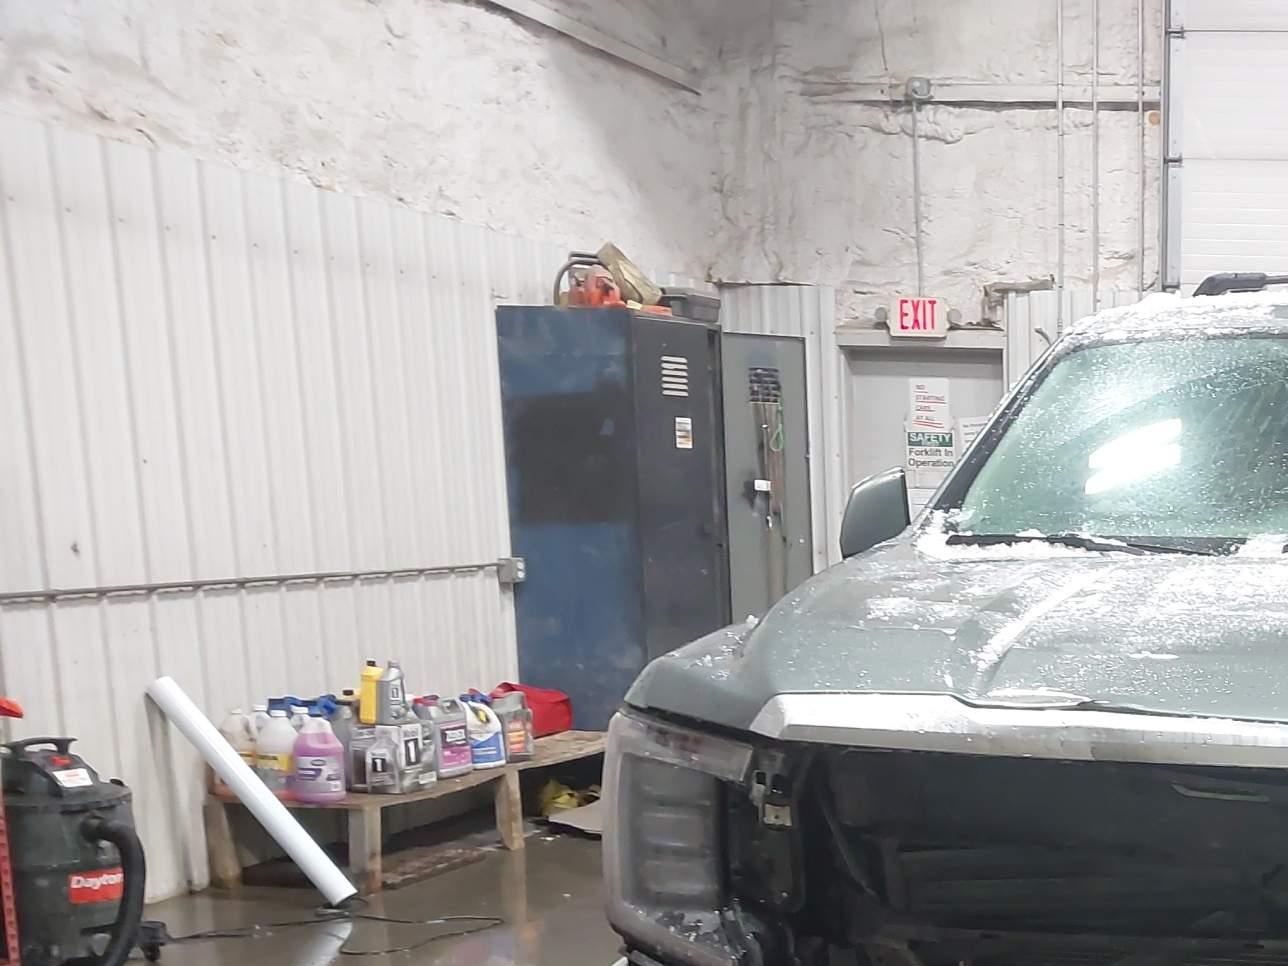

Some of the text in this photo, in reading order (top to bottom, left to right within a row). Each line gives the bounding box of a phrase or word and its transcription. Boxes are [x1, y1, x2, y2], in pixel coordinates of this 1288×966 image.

[900, 299, 937, 330] EXIT
[909, 433, 951, 443] SAFETY
[909, 448, 942, 457] Forklift
[908, 458, 955, 468] Operation
